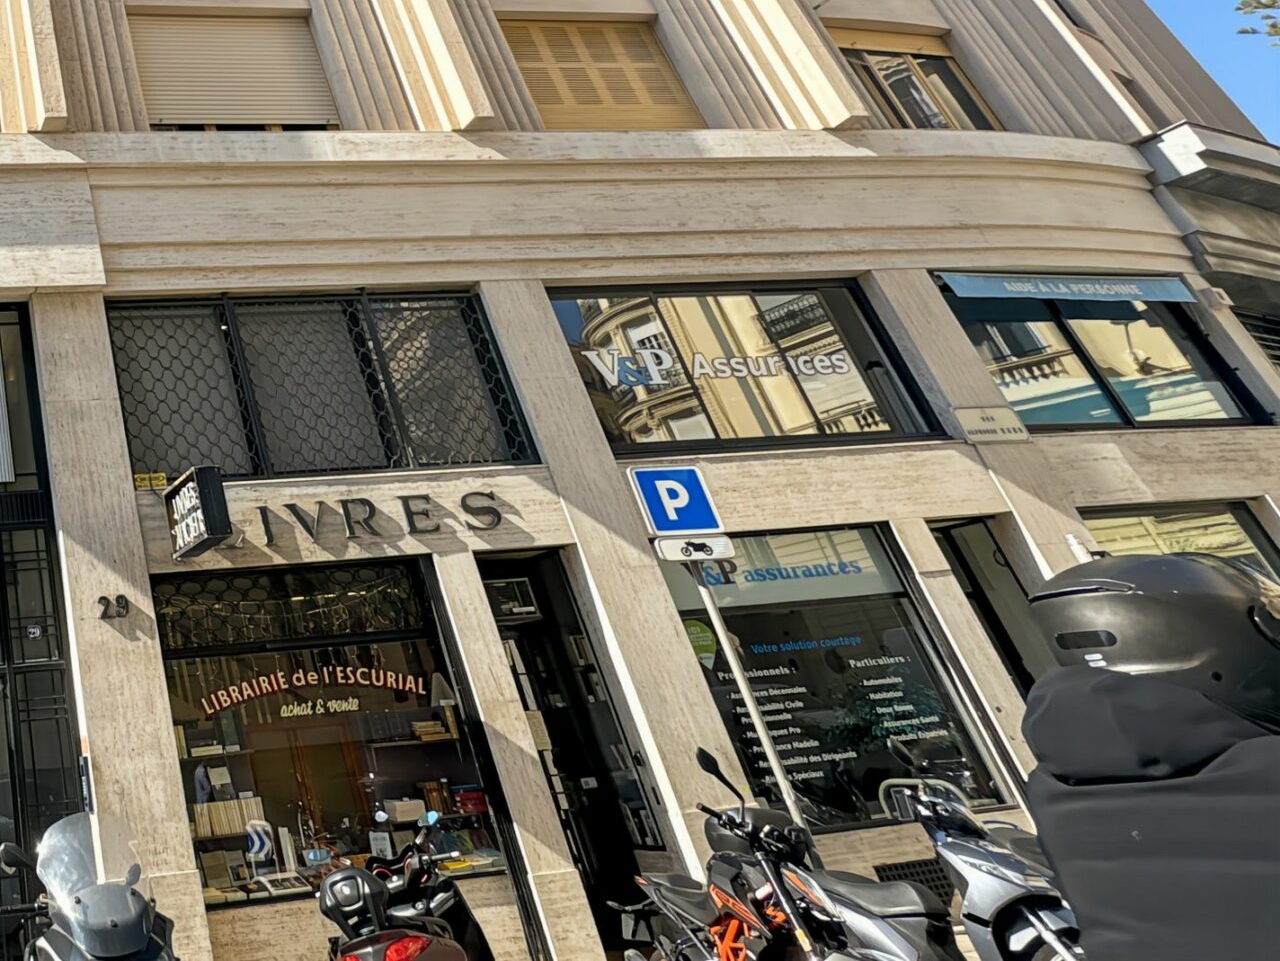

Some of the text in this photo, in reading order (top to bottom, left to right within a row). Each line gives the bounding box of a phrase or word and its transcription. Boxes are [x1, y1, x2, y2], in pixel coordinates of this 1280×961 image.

[1003, 281, 1038, 294] AIDE
[1051, 282, 1070, 295] LA
[1069, 283, 1143, 296] PERSONNE
[581, 348, 674, 387] V&P
[655, 479, 689, 521] P
[240, 491, 502, 546] IVRES
[743, 559, 863, 583] assurances
[97, 594, 129, 620] 29
[751, 635, 862, 655] Votre solution courtage
[848, 655, 906, 669] Particuliers
[201, 666, 427, 716] LIBRAIRIE de l'ESCURIAL
[281, 696, 360, 718] achat & vente
